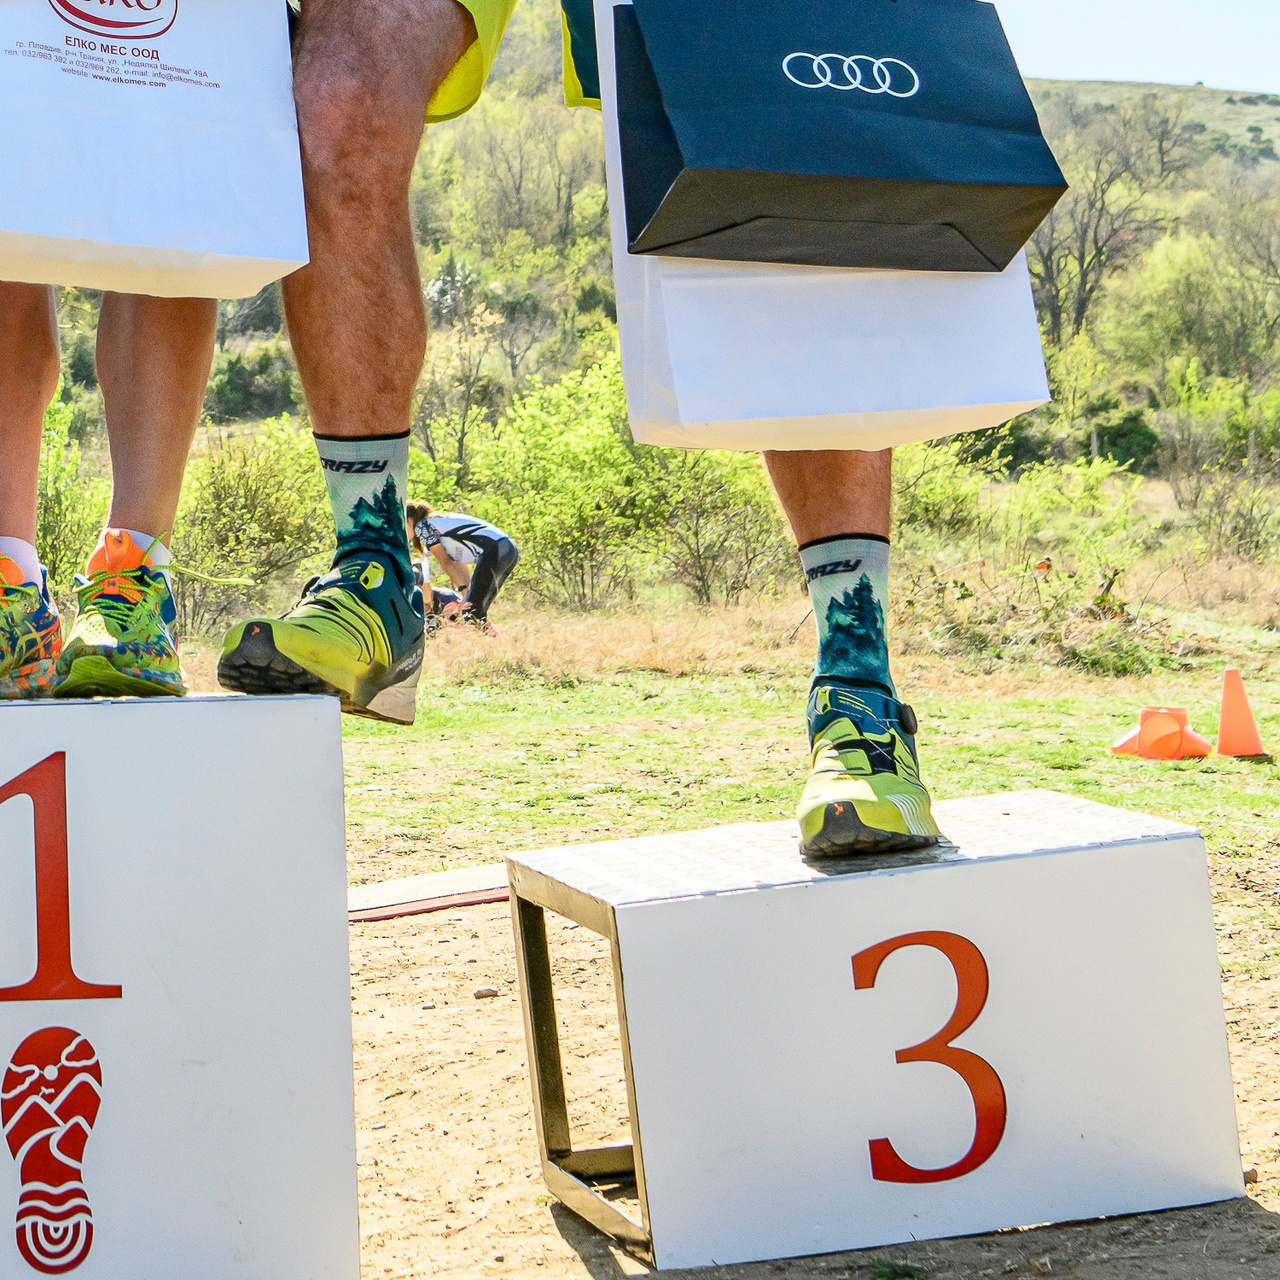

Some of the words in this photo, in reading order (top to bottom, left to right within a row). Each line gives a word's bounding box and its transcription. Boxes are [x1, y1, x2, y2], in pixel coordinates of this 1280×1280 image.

[65, 35, 97, 51] ЕЛКО
[100, 43, 127, 56] МЕС
[131, 47, 160, 61] ООД
[92, 72, 167, 88] www.elkomes.com
[851, 930, 1007, 1184] 3
